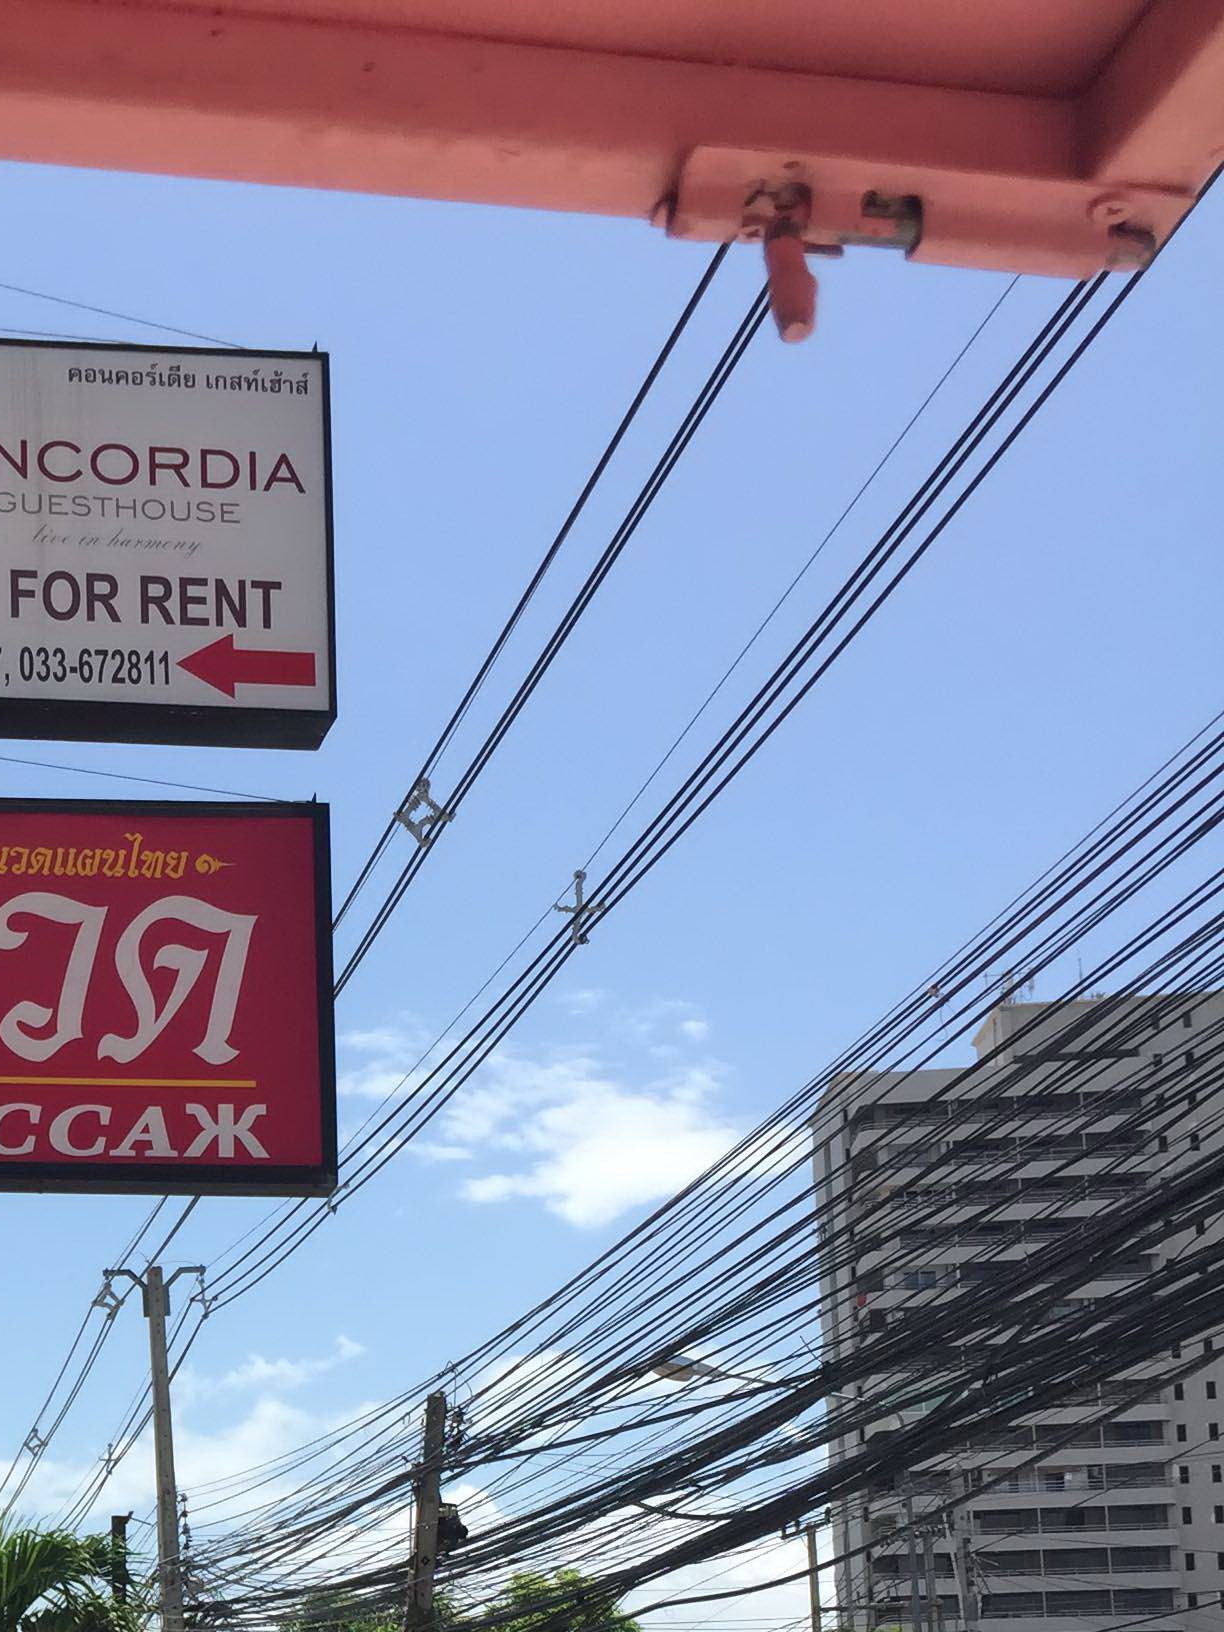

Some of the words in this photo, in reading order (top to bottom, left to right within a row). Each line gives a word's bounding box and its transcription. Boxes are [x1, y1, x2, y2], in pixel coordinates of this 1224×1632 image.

[68, 362, 196, 389] คอนคอร์เดีย
[205, 368, 310, 395] เกสท์เฮ้าส์
[32, 524, 73, 545] live
[78, 533, 100, 547] in
[107, 527, 202, 558] harmony
[10, 569, 122, 624] FOR
[140, 575, 283, 630] RENT
[19, 646, 171, 686] 033-672811
